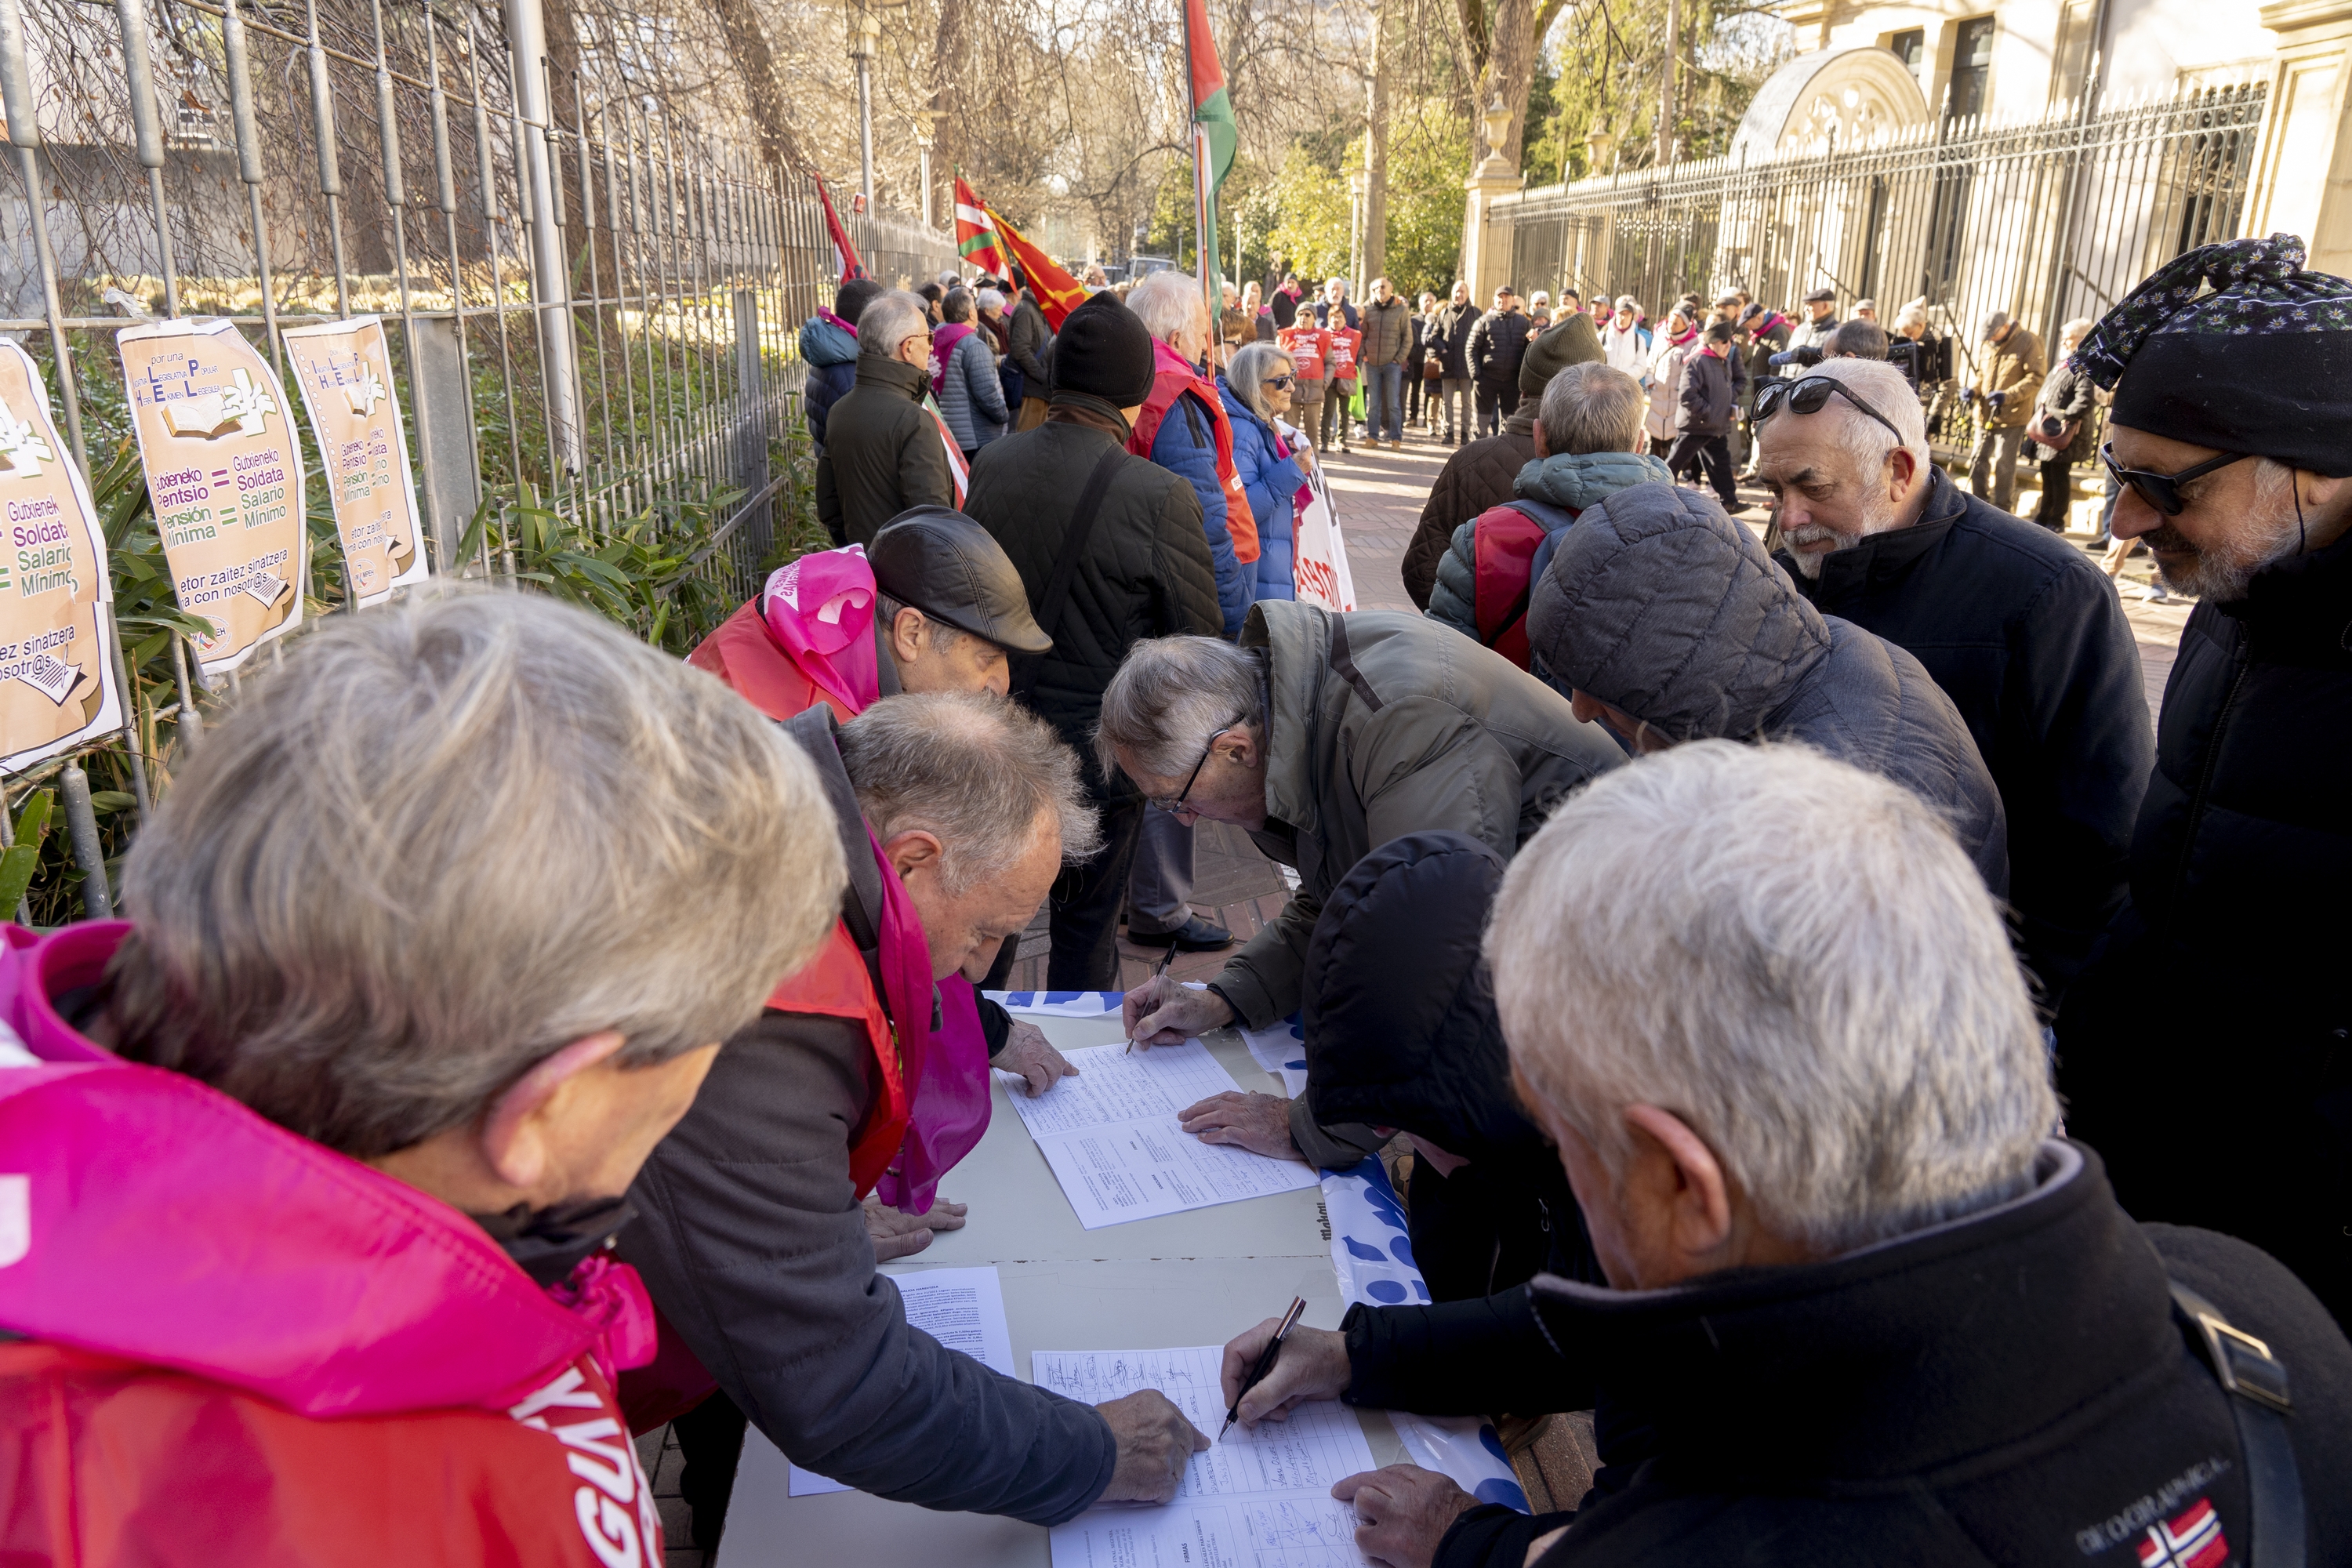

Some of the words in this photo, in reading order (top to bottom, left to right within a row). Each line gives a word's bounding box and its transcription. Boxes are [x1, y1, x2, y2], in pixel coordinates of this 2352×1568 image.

[151, 355, 164, 366] por
[167, 352, 183, 361] una
[188, 359, 219, 377] POPULAR
[153, 385, 184, 403] EKIMEN
[233, 448, 278, 472] Gutxieneko
[238, 467, 284, 492] Soldata
[8, 495, 60, 521] Gutxienek
[158, 486, 209, 507] Pentsio
[241, 488, 285, 510] Salario
[162, 506, 212, 530] Pensión
[245, 504, 286, 530] Mínimo
[165, 525, 216, 551] Mínima
[358, 538, 372, 550] con
[210, 565, 245, 586] zaitez
[248, 549, 288, 570] sinatzera
[194, 591, 220, 604] con
[224, 572, 267, 597] nosotr@s
[24, 626, 74, 655] sinatzera
[0, 655, 50, 681] osotr@s
[1181, 1543, 1190, 1563] FIRMAS
